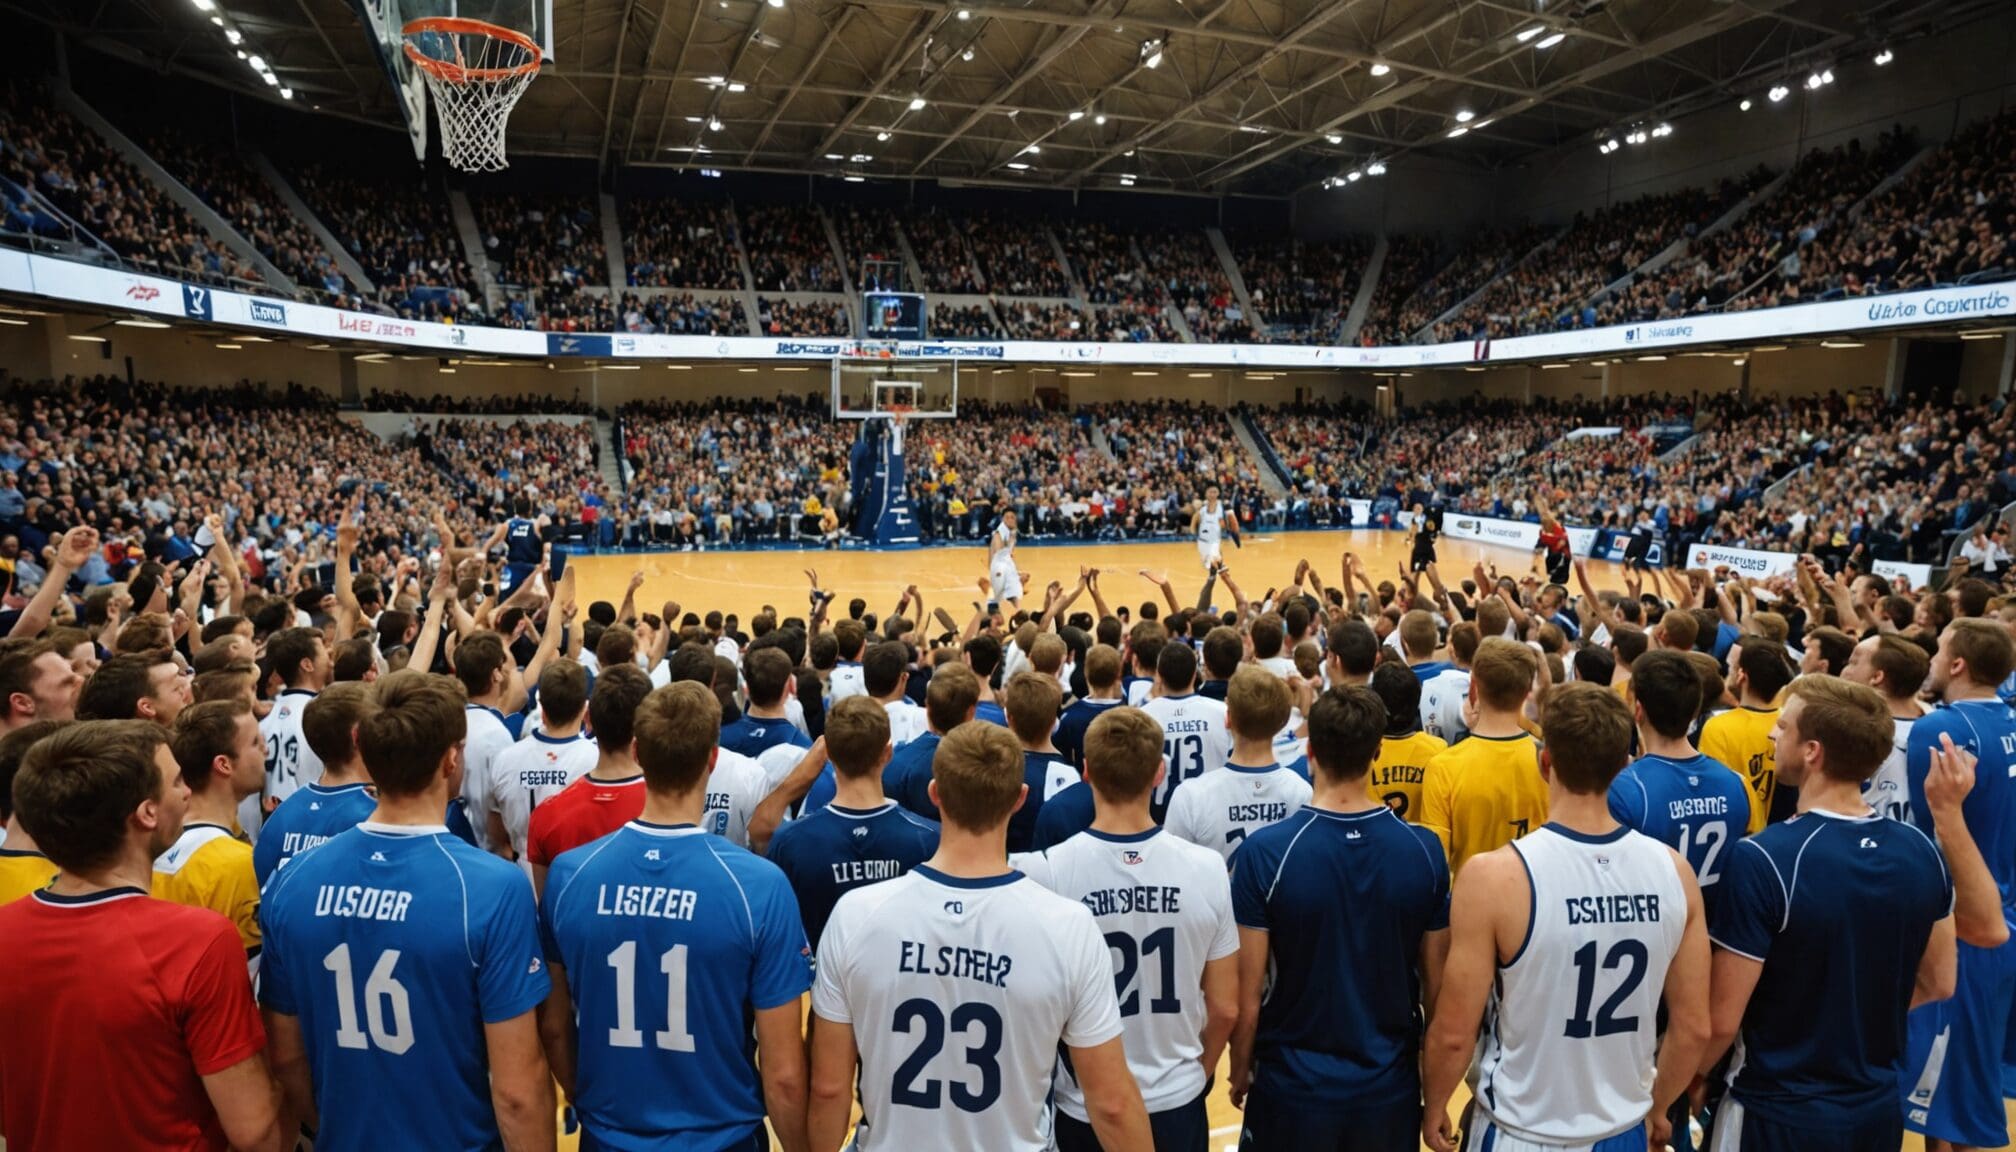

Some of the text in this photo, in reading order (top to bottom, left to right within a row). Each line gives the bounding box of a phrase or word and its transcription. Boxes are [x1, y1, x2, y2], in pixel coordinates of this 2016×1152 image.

[323, 943, 415, 1055] 16
[607, 940, 696, 1053] 11
[1563, 938, 1649, 1039] 12
[891, 997, 1003, 1113] 23
